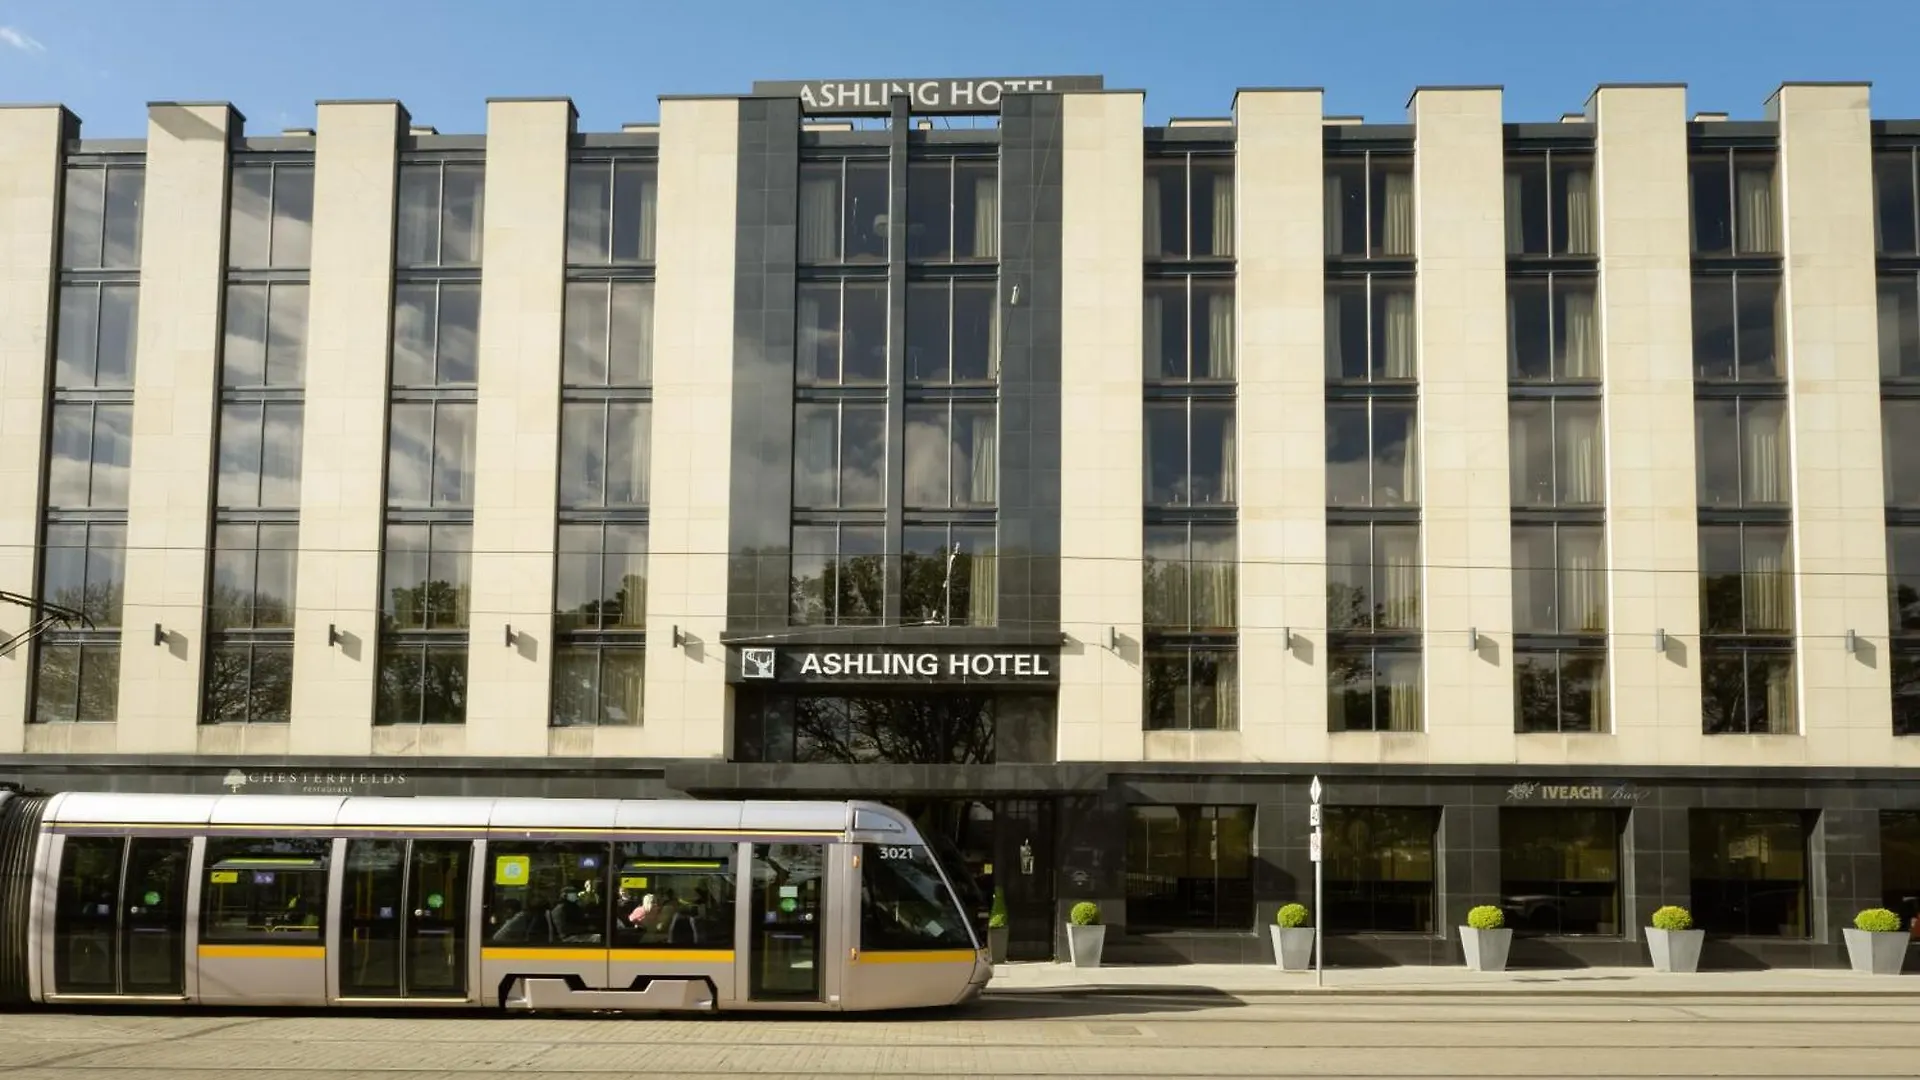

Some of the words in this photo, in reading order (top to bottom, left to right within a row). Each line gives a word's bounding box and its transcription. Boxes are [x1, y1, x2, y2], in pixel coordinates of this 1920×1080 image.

[800, 653, 938, 675] ASHLING
[950, 653, 1049, 675] HOTEL
[249, 773, 406, 784] CHESTERFIELDS
[1543, 786, 1603, 799] IVEAGH
[879, 847, 913, 859] 3021
